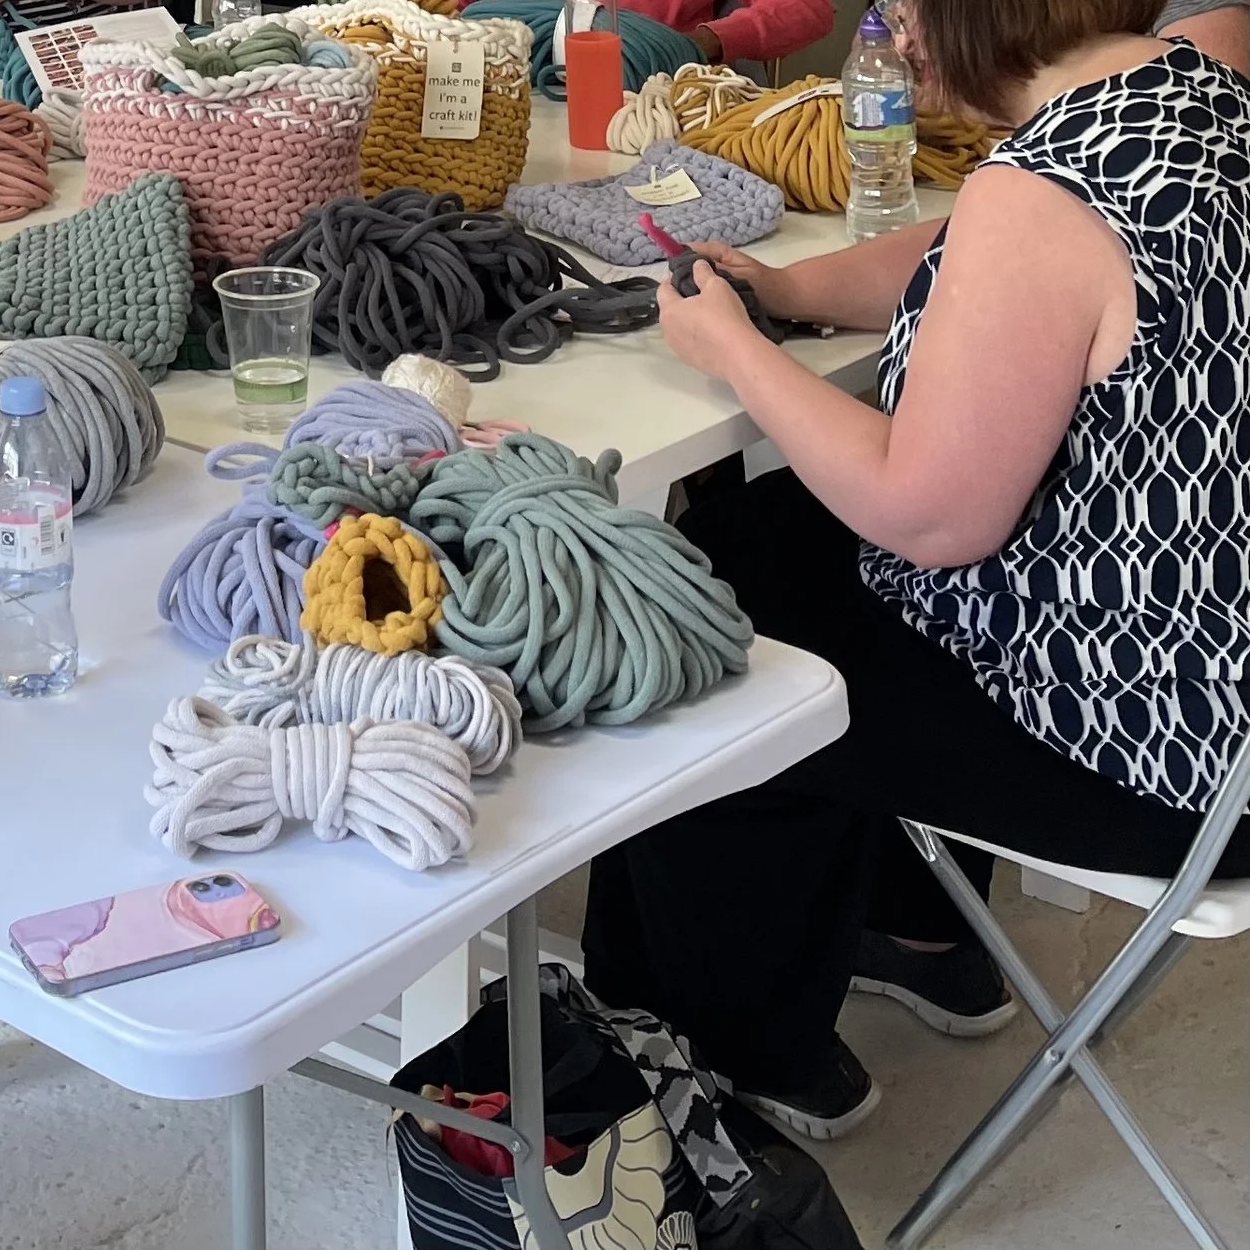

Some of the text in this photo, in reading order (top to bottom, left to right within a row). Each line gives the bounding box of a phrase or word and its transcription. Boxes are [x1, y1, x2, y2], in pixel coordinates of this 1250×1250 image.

[428, 75, 481, 87] make me
[439, 92, 467, 104] I'm a
[429, 109, 478, 121] craft kit!
